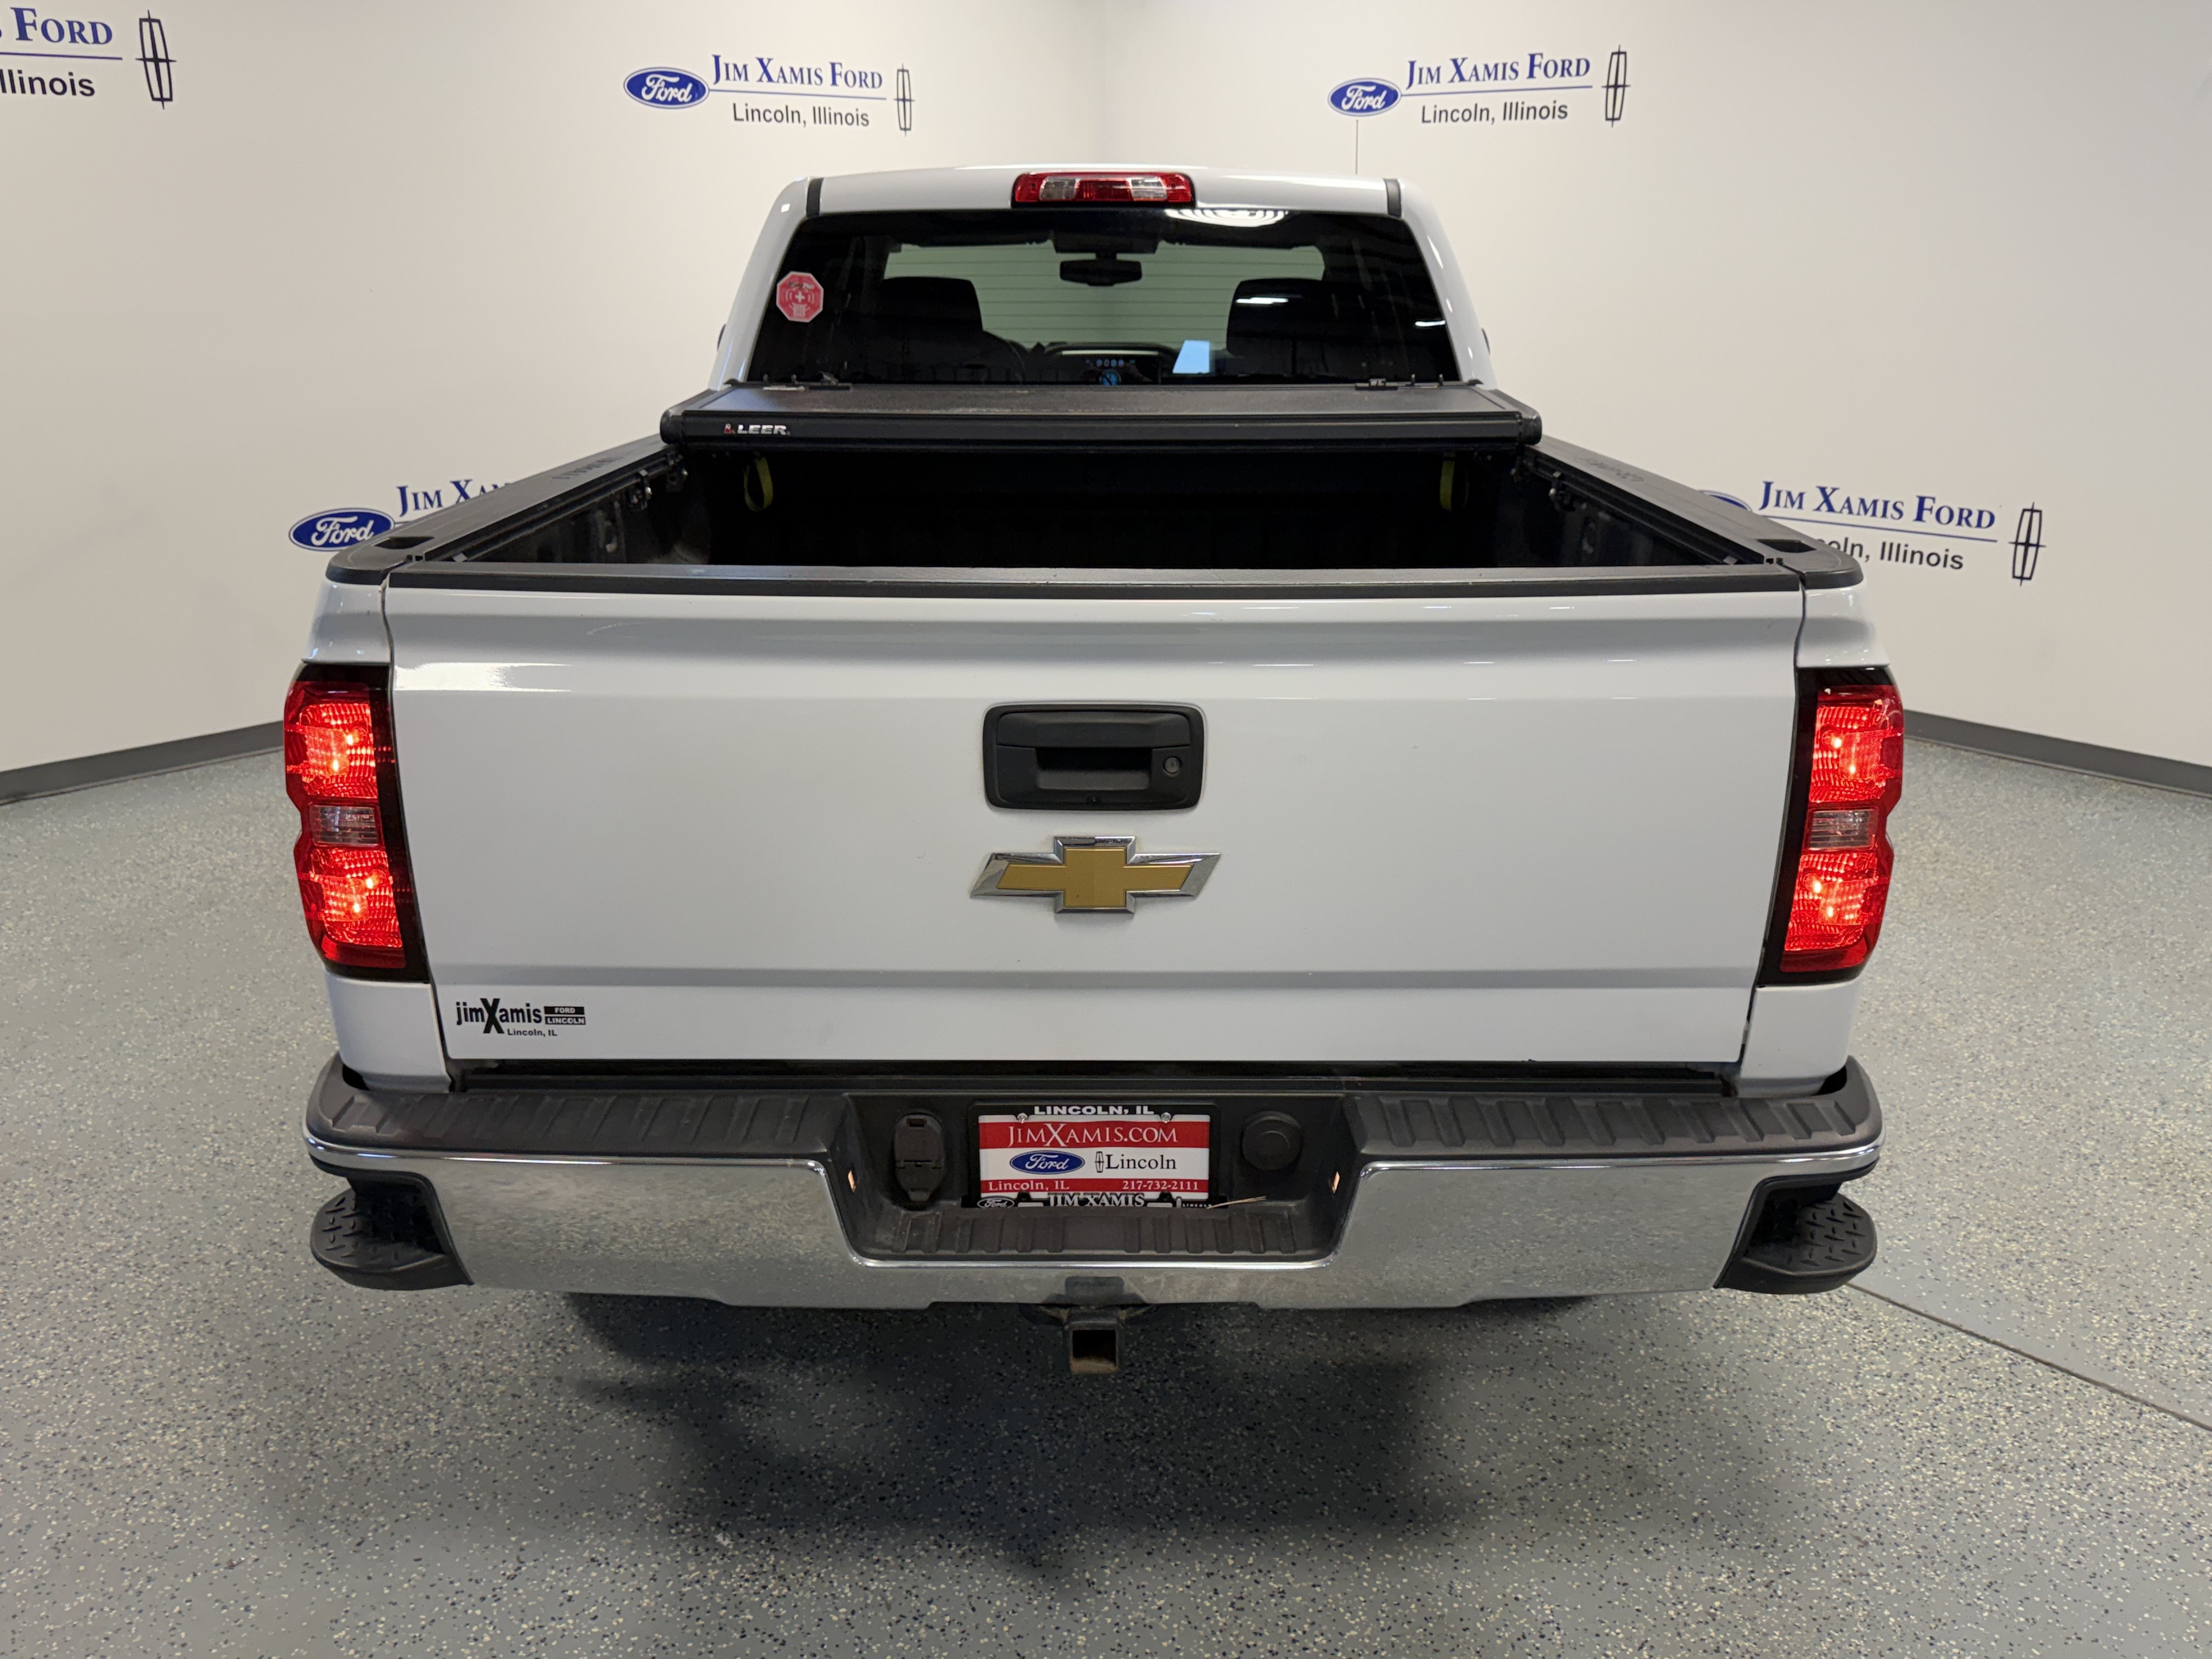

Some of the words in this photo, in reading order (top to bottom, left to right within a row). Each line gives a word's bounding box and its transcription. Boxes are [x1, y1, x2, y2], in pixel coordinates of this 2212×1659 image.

[10, 7, 113, 45] FORD
[0, 69, 95, 97] llinois
[712, 54, 749, 84] JIM
[755, 57, 823, 86] XAMIS
[829, 61, 883, 89] FORD
[1406, 60, 1442, 89] JIM
[1448, 57, 1519, 83] XAMIS
[1526, 53, 1590, 79] FORD
[641, 74, 693, 103] Ford
[1341, 85, 1387, 110] Ford
[733, 103, 807, 127] Lincoln,
[813, 106, 870, 127] Illinois
[1421, 103, 1496, 125] Lincoln,
[1502, 100, 1568, 121] Illinois
[737, 424, 787, 435] LEER
[396, 485, 444, 518] JIM
[1758, 481, 1806, 511] JIM
[1813, 486, 1905, 520] XAMIS
[1913, 495, 1996, 529] FORD
[311, 516, 375, 546] Ford
[1880, 541, 1964, 569] Illinois
[507, 1029, 546, 1037] Lincoln,
[1034, 1105, 1128, 1115] LINCOLN,
[1136, 1105, 1154, 1115] IL
[1008, 1123, 1178, 1147] JIMXAMIS.COM
[1024, 1153, 1069, 1170] Ford
[1105, 1154, 1177, 1170] Lincoln
[989, 1180, 1049, 1191] Lincoln,
[1055, 1180, 1070, 1190] IL
[1122, 1181, 1199, 1190] 217-732-2111
[1048, 1193, 1080, 1207] JIM
[1084, 1193, 1145, 1207] XAMIS
